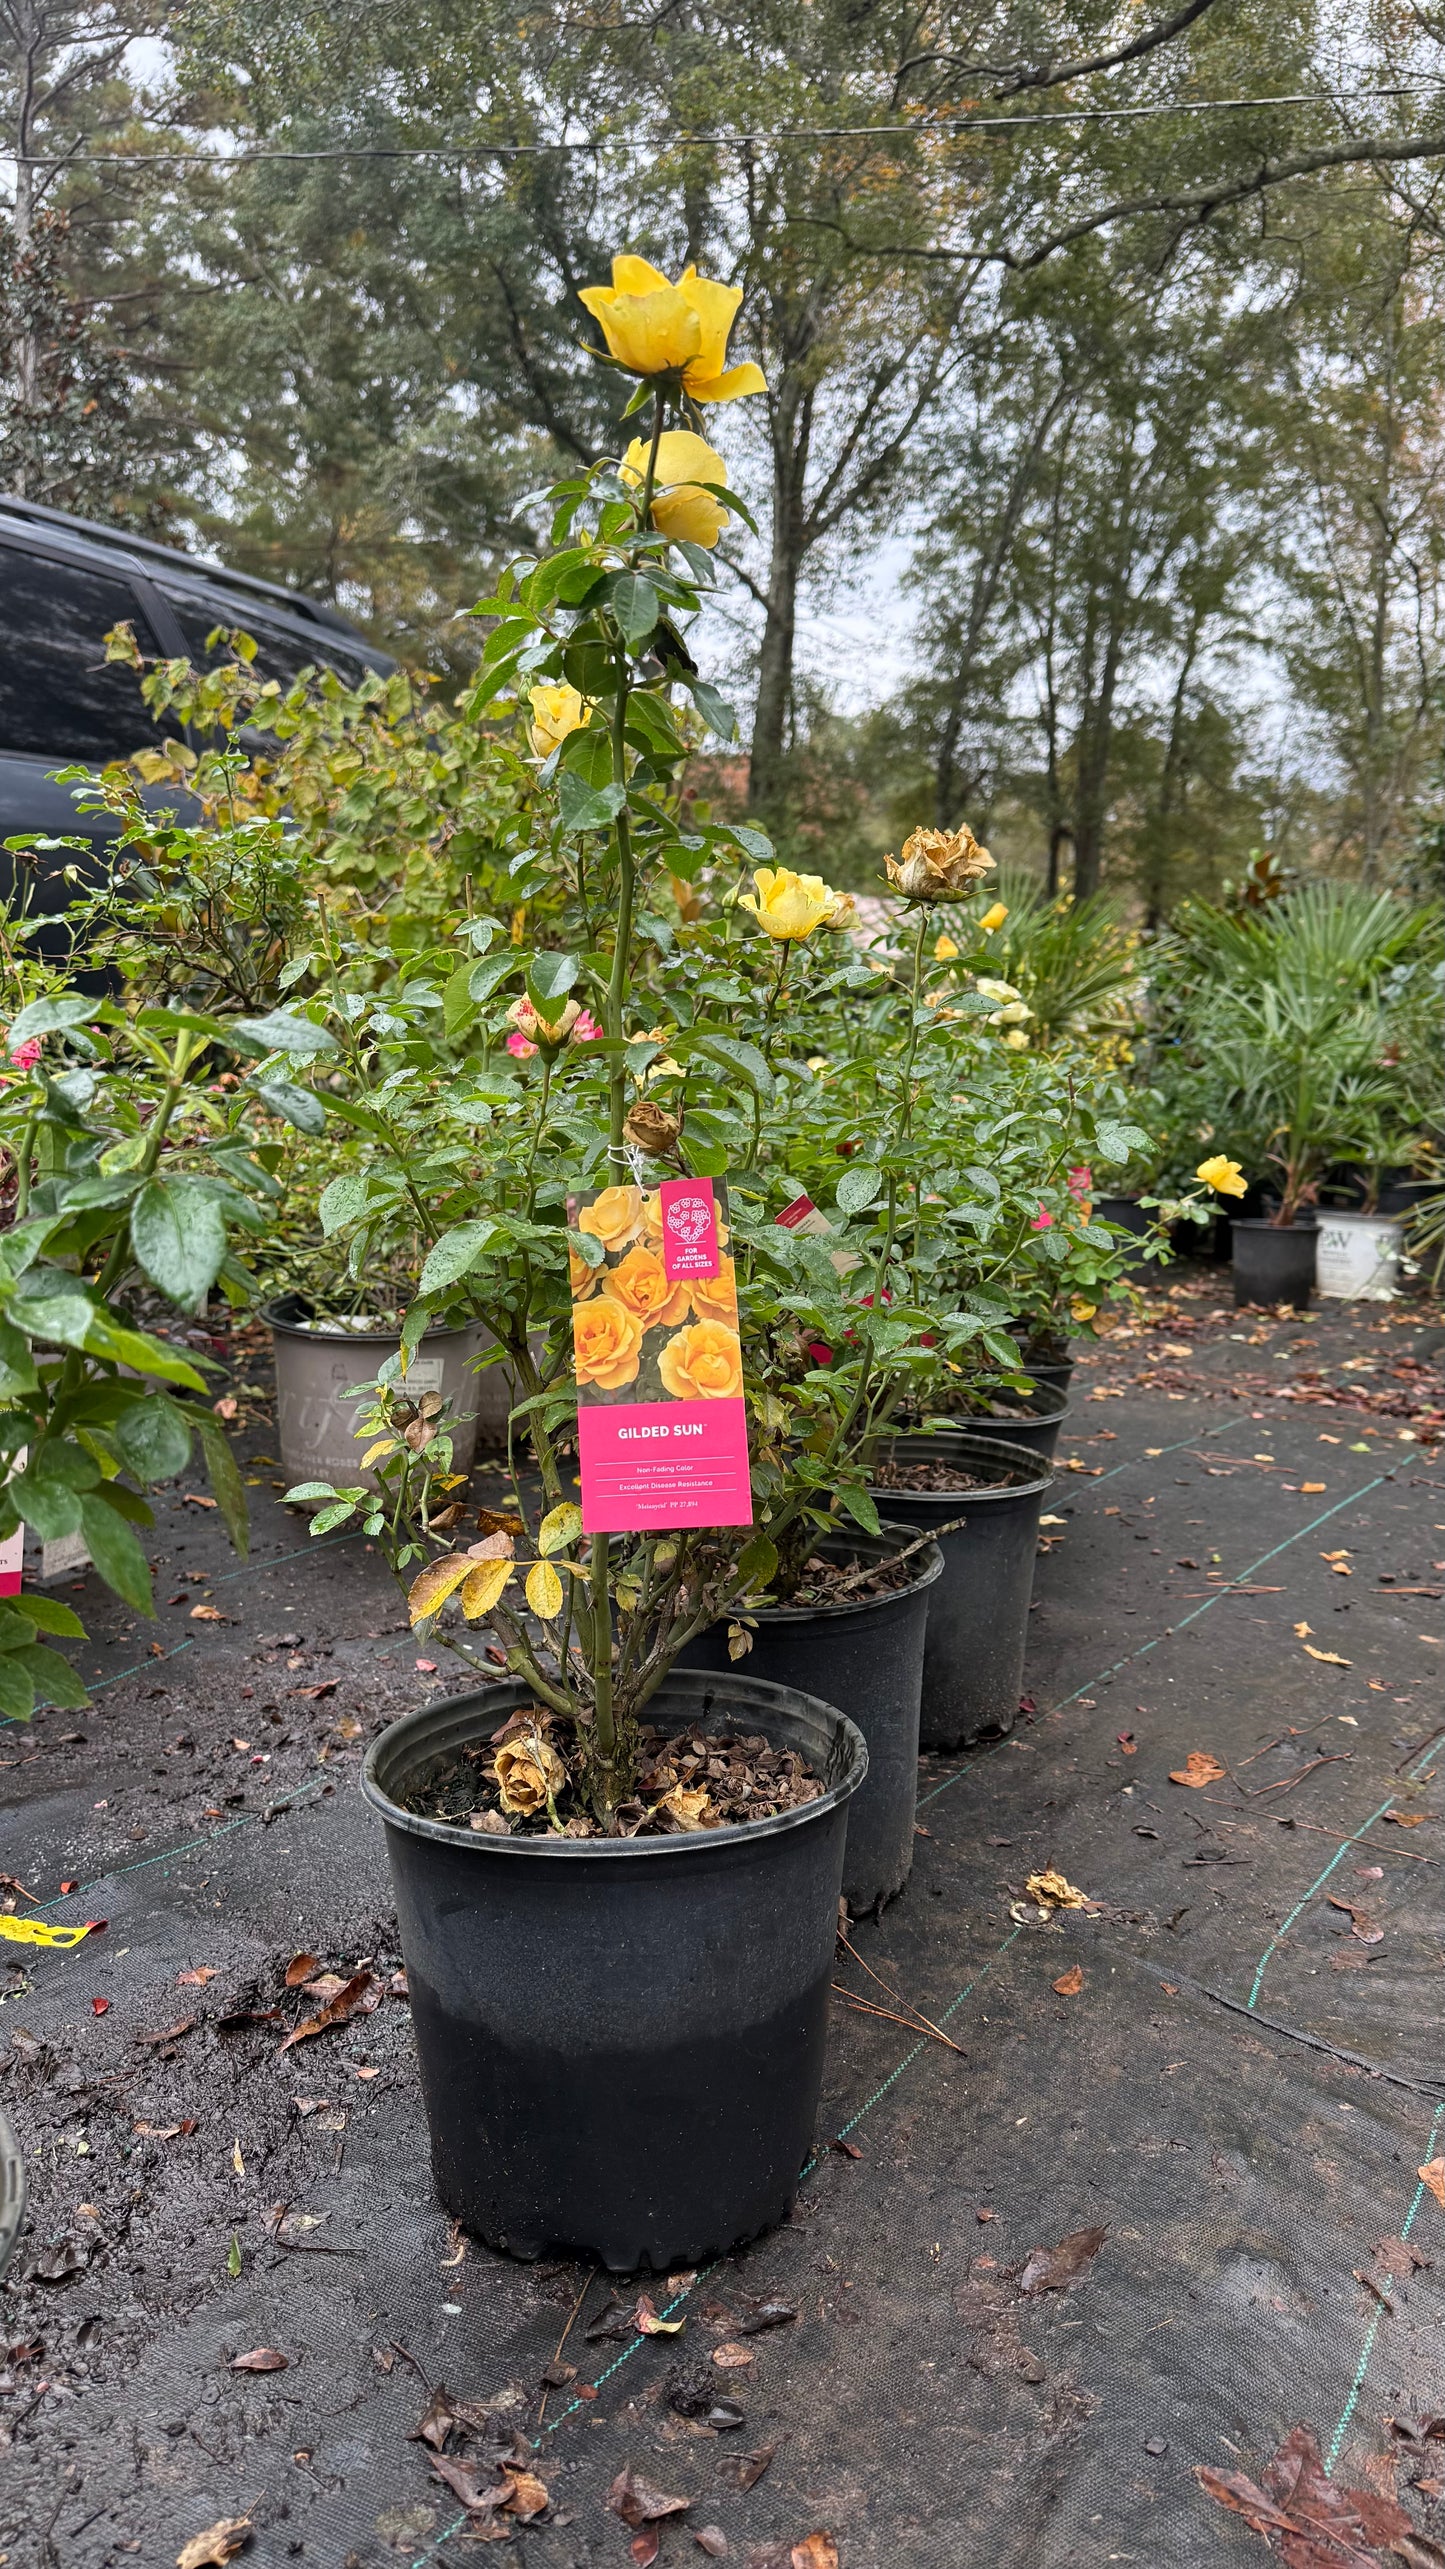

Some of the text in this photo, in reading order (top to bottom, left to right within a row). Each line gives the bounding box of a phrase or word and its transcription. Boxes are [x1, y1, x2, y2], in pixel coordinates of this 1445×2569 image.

[676, 1254, 707, 1262] GARDENS
[618, 1425, 670, 1440] GILDED
[636, 1464, 694, 1474] Non-Fading Color
[619, 1483, 649, 1491] Excellent
[677, 1480, 713, 1488] Resistance
